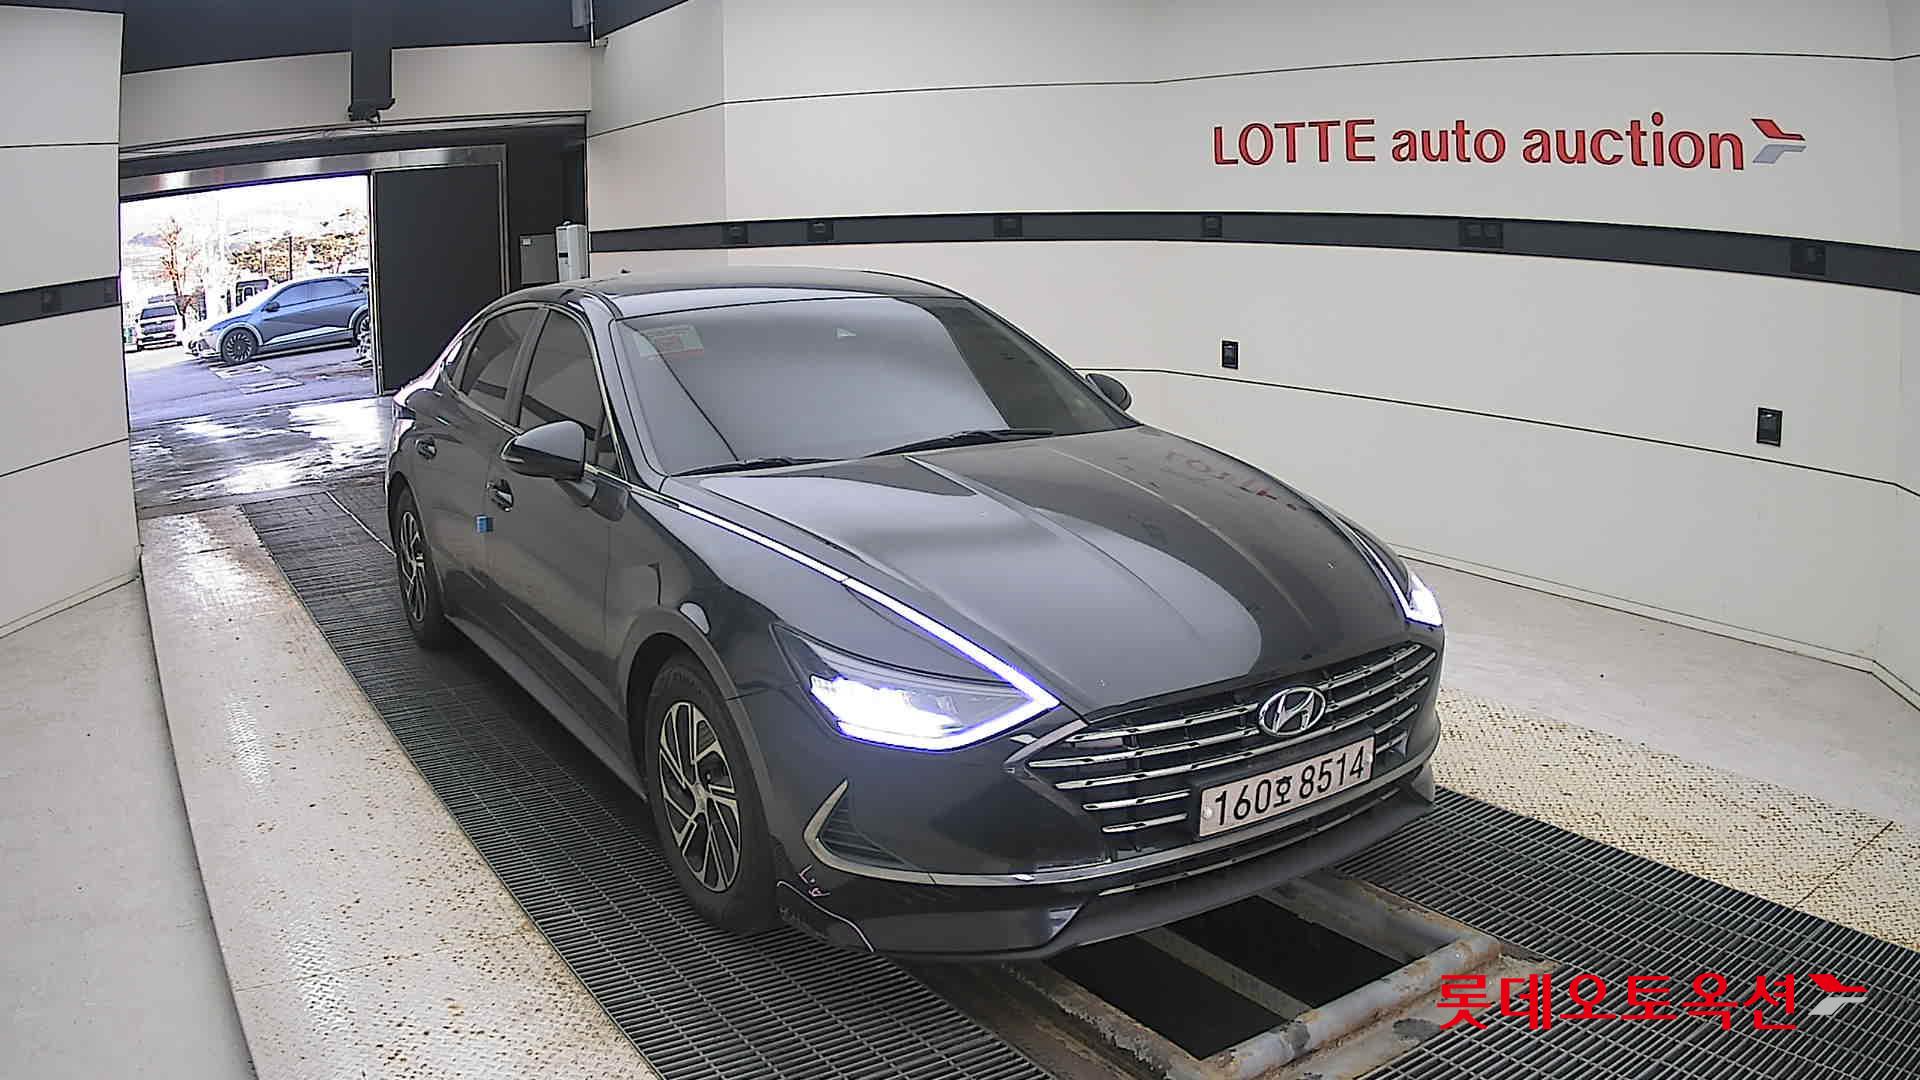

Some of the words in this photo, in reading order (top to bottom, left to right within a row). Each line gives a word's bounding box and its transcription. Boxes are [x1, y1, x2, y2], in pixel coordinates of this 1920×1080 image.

[1213, 118, 1376, 166] LOTTE
[1391, 119, 1507, 164] auto
[1522, 111, 1745, 171] auction
[1214, 775, 1293, 826] 160호
[1299, 745, 1365, 800] 8514
